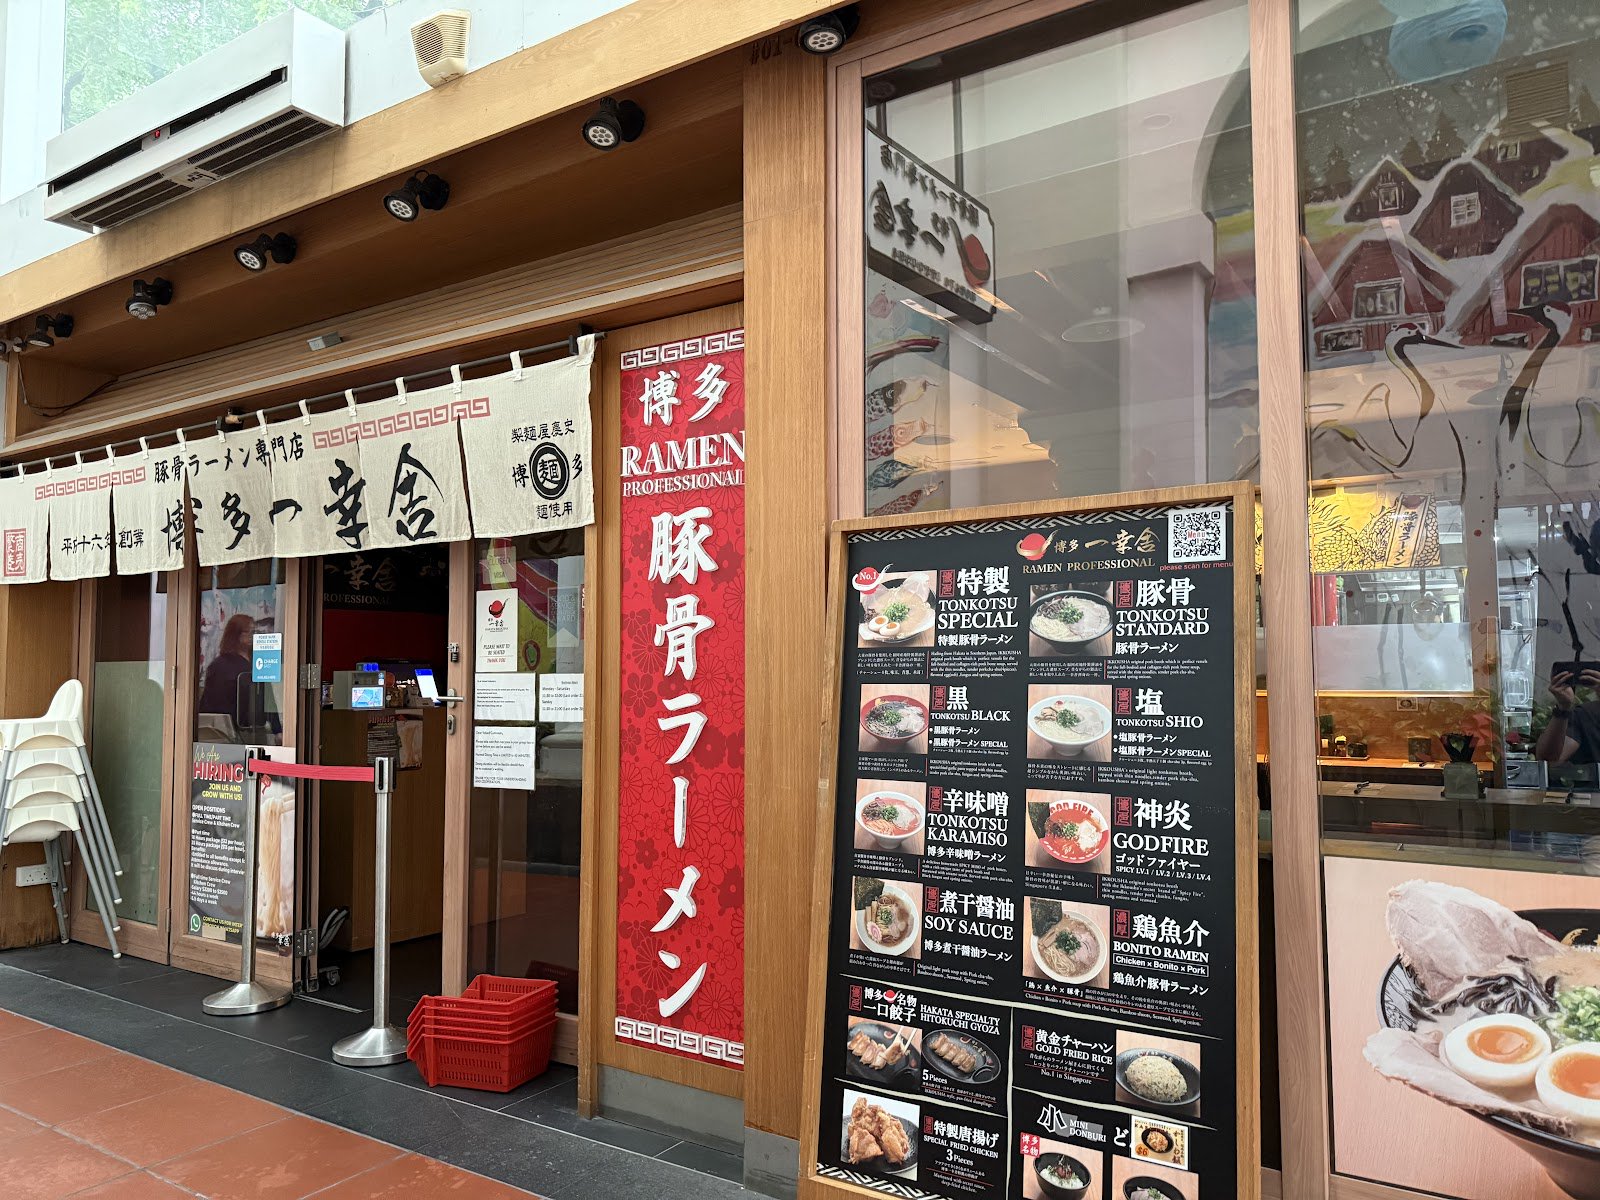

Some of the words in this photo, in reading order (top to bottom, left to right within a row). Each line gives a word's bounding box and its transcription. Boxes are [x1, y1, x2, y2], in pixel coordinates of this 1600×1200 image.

[639, 362, 731, 427] 博多
[154, 432, 304, 484] 豚骨ラーメン専門店
[620, 430, 745, 477] RAMEN
[622, 468, 745, 497] PROFESSIONAL
[1187, 531, 1206, 539] Menu
[1022, 563, 1062, 574] RAMEN
[1067, 558, 1155, 571] PROFESSIONAL
[957, 566, 1010, 596] 特製
[323, 592, 393, 606] ROFESSIONAL
[1136, 577, 1195, 607] 豚骨
[939, 597, 1018, 611] TONKOTSU
[938, 612, 1018, 629] SPECIAL
[1116, 608, 1209, 623] TONKOTSU
[1115, 622, 1209, 636] STANDARD
[937, 634, 1013, 646] 特製豚骨ラーメン
[1115, 642, 1179, 655] 豚骨ラーメン
[947, 686, 969, 710] 黒
[1135, 688, 1165, 716] 塩
[931, 712, 970, 720] TONKOTSU
[971, 710, 1010, 721] BLACK
[1116, 718, 1164, 727] TONKOTSU
[1165, 716, 1203, 728] SHIO
[934, 726, 980, 735] 黒豚骨ラーメン
[1118, 733, 1177, 743] 塩豚骨ラーメン
[933, 738, 979, 747] 黒豚骨ラーメン
[1118, 746, 1177, 757] 塩豚骨ラーメン
[1177, 749, 1211, 757] SPECIAL
[647, 505, 718, 1019] 豚骨ラーメン
[193, 762, 244, 783] HIRING
[202, 791, 216, 799] GROW
[217, 792, 230, 800] WITH
[209, 782, 221, 791] JOIN
[222, 783, 229, 791] US
[230, 784, 241, 792] AND
[943, 788, 1009, 817] 辛味噌
[927, 813, 1008, 832] TONKOTSU
[1134, 797, 1192, 831] 神炎
[927, 827, 1008, 846] KARAMISO
[1113, 832, 1209, 857] GODFIRE
[927, 845, 1006, 863] 博多辛味噌ラーメン
[1115, 866, 1135, 874] SPICY
[1136, 867, 1149, 875] LV.1
[1156, 869, 1171, 877] LV.2
[1196, 873, 1211, 881] LV.4
[940, 890, 1015, 921] 煮干醤油
[925, 916, 955, 932] SOY
[959, 919, 1014, 940] SAUCE
[1132, 914, 1210, 947] 鶏魚介
[924, 939, 1013, 962] 博多煮干醤油ラーメン
[1113, 941, 1161, 957] BONITO
[1163, 949, 1209, 963] RAMEN
[1115, 955, 1146, 966] Chicken
[1154, 961, 1179, 971] Bonito
[1187, 965, 1206, 975] Pork
[1112, 971, 1209, 996] 鶏魚介豚骨ラーメン
[864, 987, 883, 1001] 博多
[896, 994, 918, 1007] 名物
[864, 1003, 917, 1023] 一口餃子
[920, 1004, 953, 1017] HAKATA
[955, 1011, 1000, 1026] SPECIALTY
[920, 1013, 968, 1029] HITOKUCHI
[970, 1022, 1000, 1035] GYOZA
[1036, 1029, 1114, 1054] 黄金チャーハン
[1036, 1043, 1061, 1055] GOLD
[1063, 1048, 1089, 1060] FRIED
[1092, 1054, 1113, 1065] RICE
[922, 1069, 929, 1081] 5
[929, 1074, 948, 1084] Pieces
[1041, 1069, 1055, 1077] No.1
[1064, 1072, 1092, 1085] Singapore
[1037, 1103, 1067, 1133] 小
[1070, 1119, 1088, 1130] MINI
[934, 1120, 999, 1148] 特製唐揚げ
[1021, 1134, 1039, 1145] 博多
[1069, 1128, 1106, 1143] DONBURI
[1113, 1126, 1131, 1147] ど
[924, 1135, 948, 1146] SPECIAL
[950, 1141, 968, 1151] FRIED
[970, 1146, 998, 1158] CHICKEN
[1022, 1145, 1039, 1156] 名物
[946, 1149, 953, 1161] 3
[954, 1155, 973, 1166] Pieces
